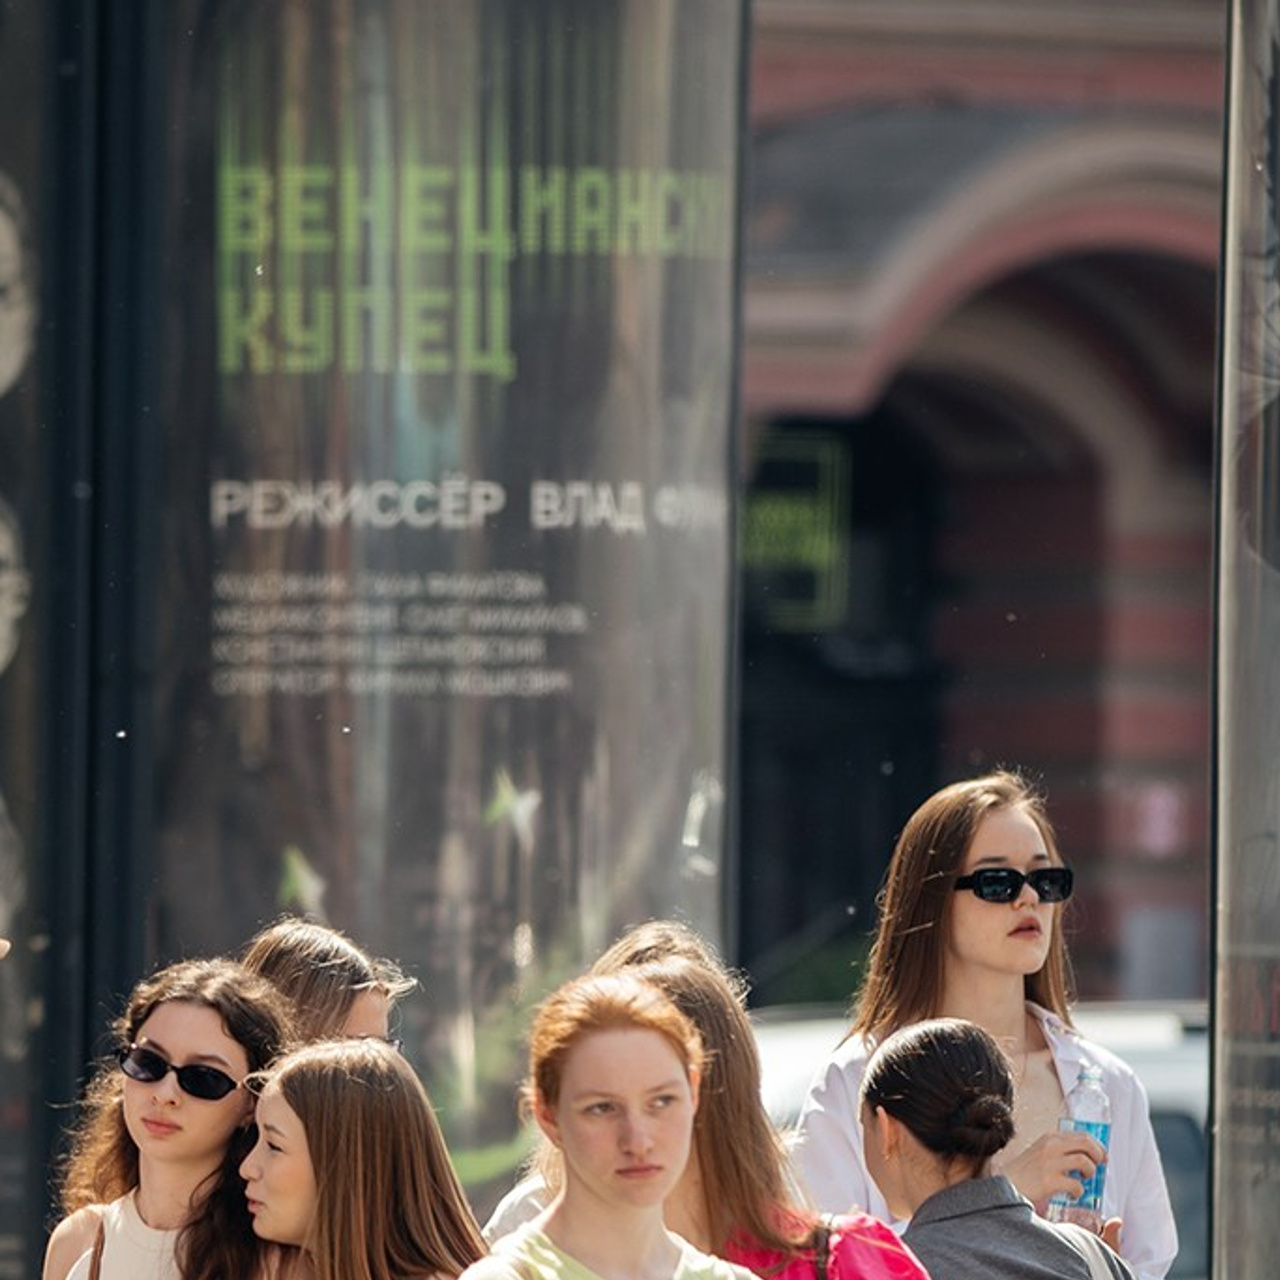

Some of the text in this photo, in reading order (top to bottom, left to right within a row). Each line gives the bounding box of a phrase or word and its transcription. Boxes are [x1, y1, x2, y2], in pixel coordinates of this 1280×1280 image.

[219, 289, 516, 381] КУПЕЦ
[211, 472, 506, 530] РЕЖИССЁР
[530, 480, 646, 535] ВЛАД
